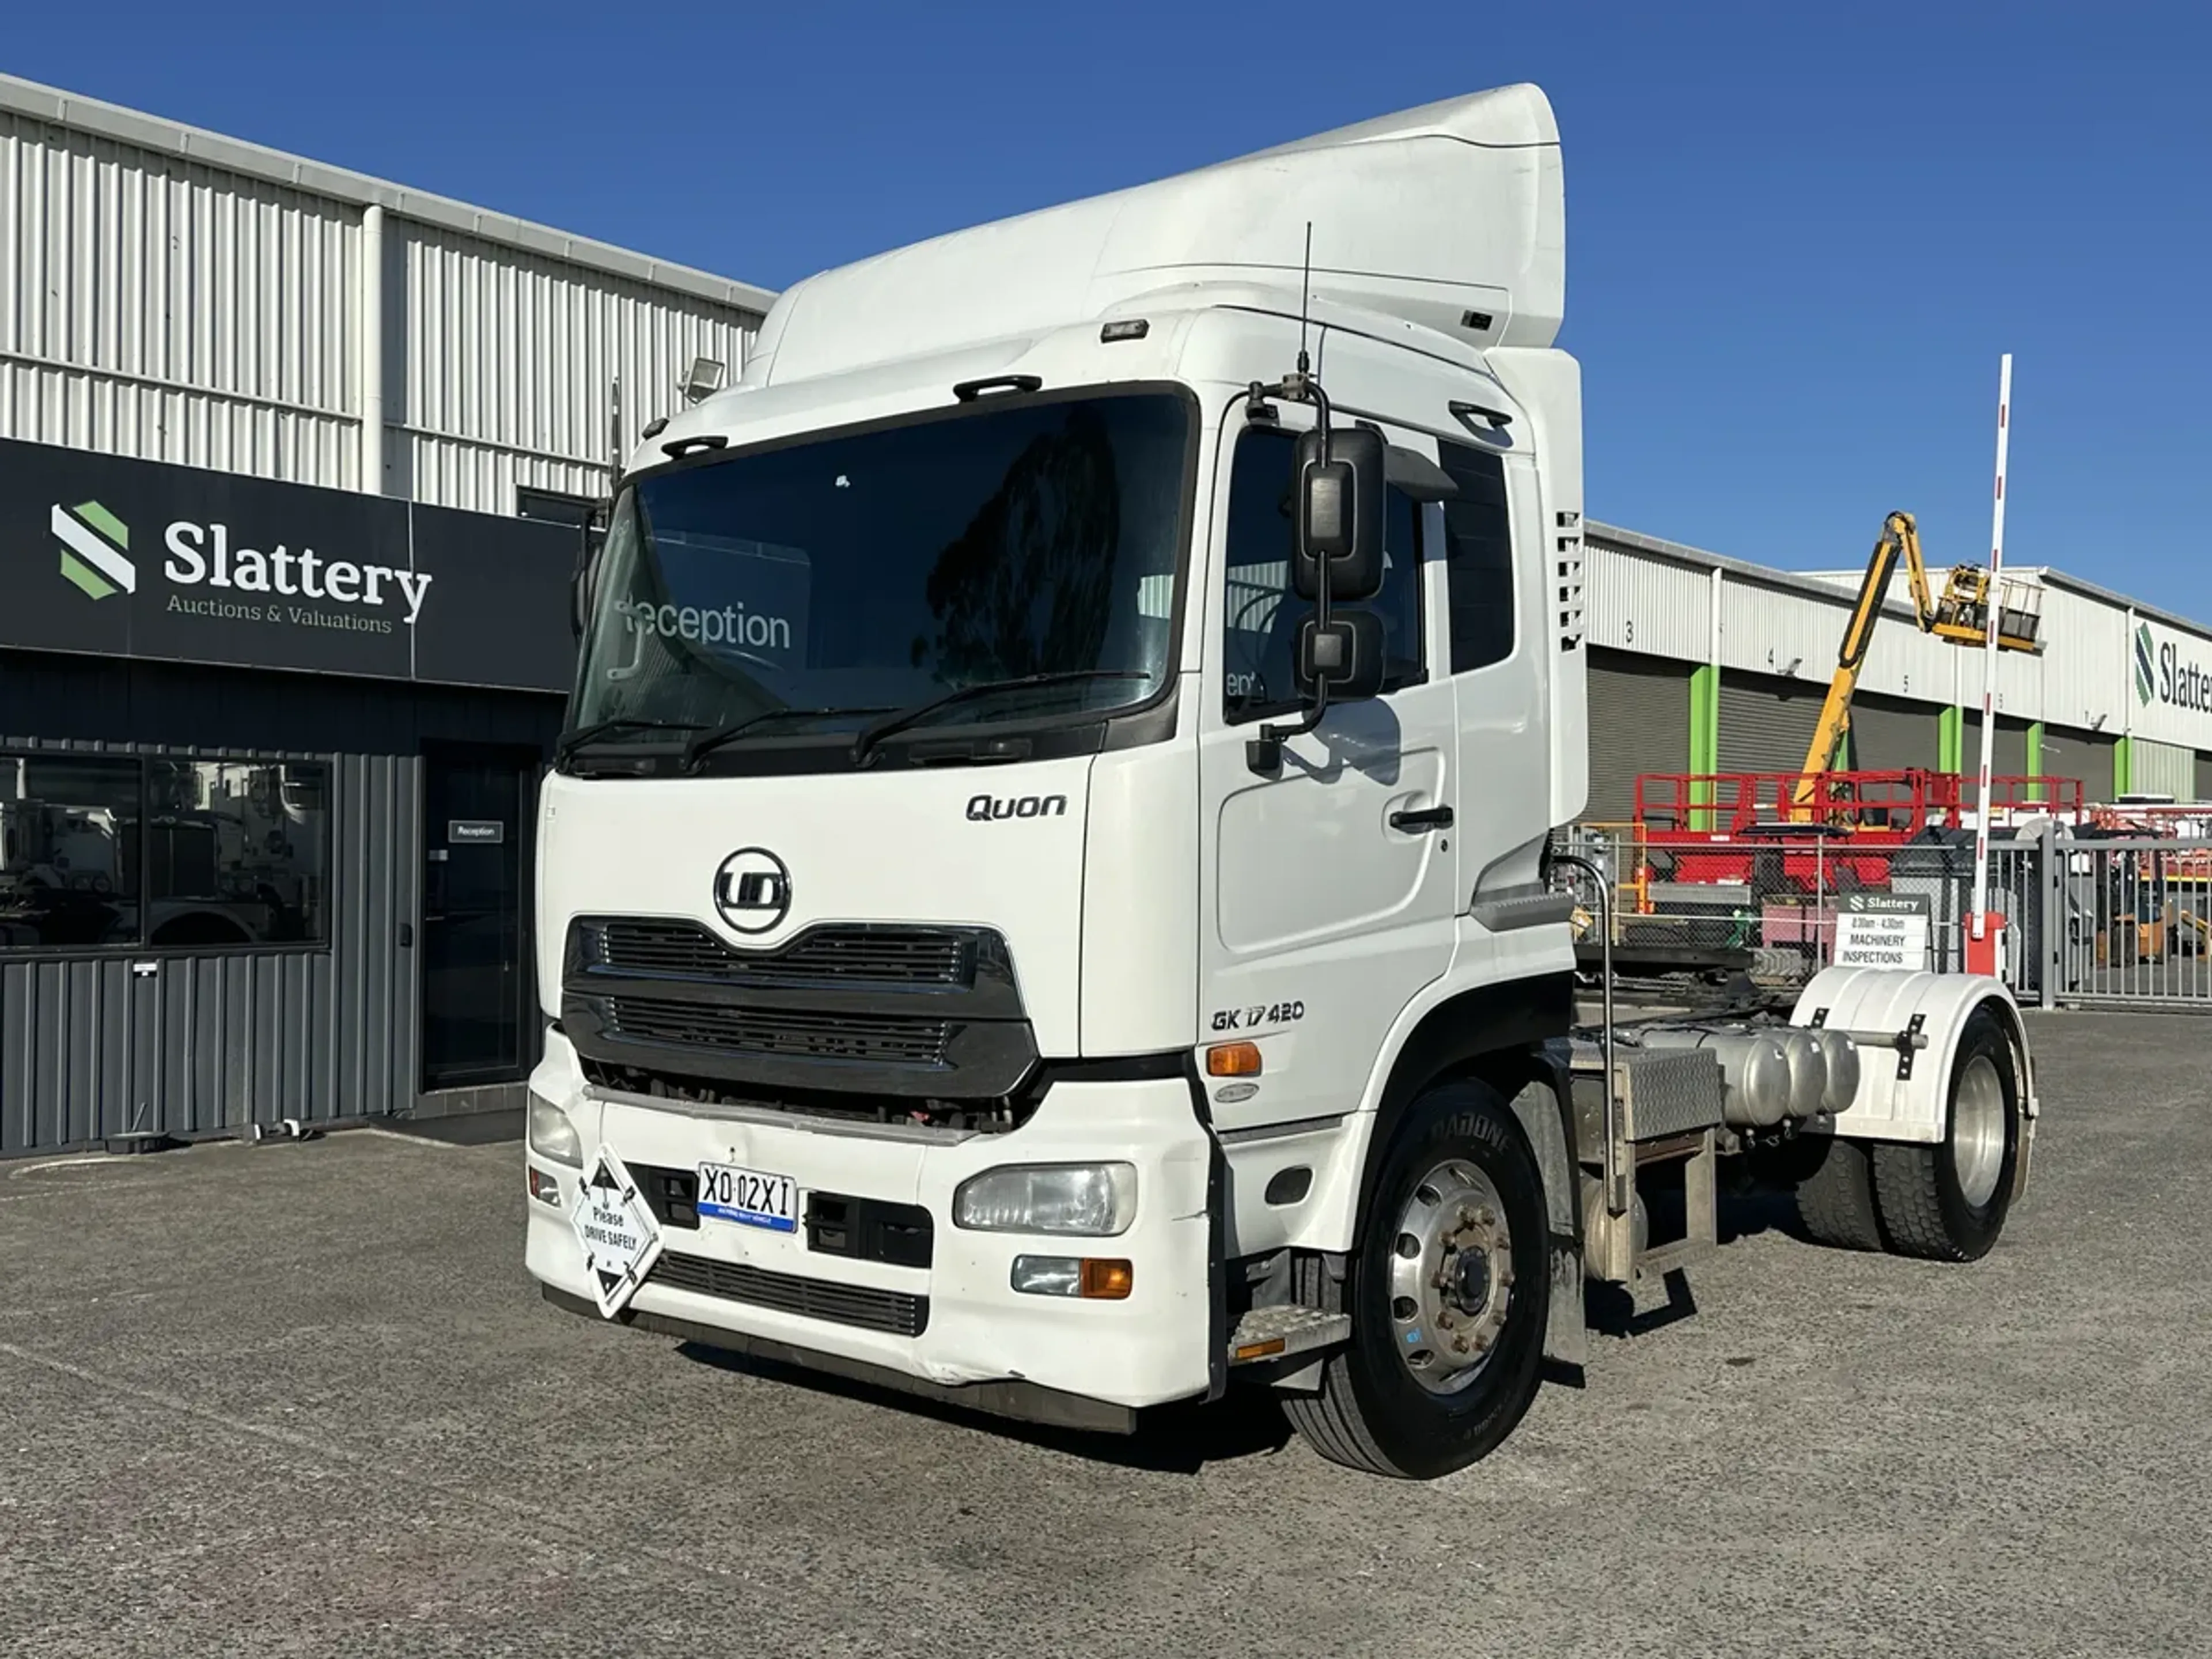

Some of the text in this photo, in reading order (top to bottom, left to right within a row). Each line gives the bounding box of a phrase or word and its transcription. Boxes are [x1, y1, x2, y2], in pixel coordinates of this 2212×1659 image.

[164, 521, 432, 624] Slattery
[166, 594, 392, 634] Auctions & Valuations
[1626, 620, 1633, 643] 3
[965, 794, 1068, 821] Quon
[457, 825, 495, 838] Reception
[1867, 896, 1919, 912] Slattery
[1850, 934, 1906, 946] MACHINERY
[1842, 950, 1903, 964] INSPECTIONS
[1211, 1009, 1241, 1031] GK
[1267, 1001, 1304, 1024] 420
[593, 1206, 624, 1228] Please
